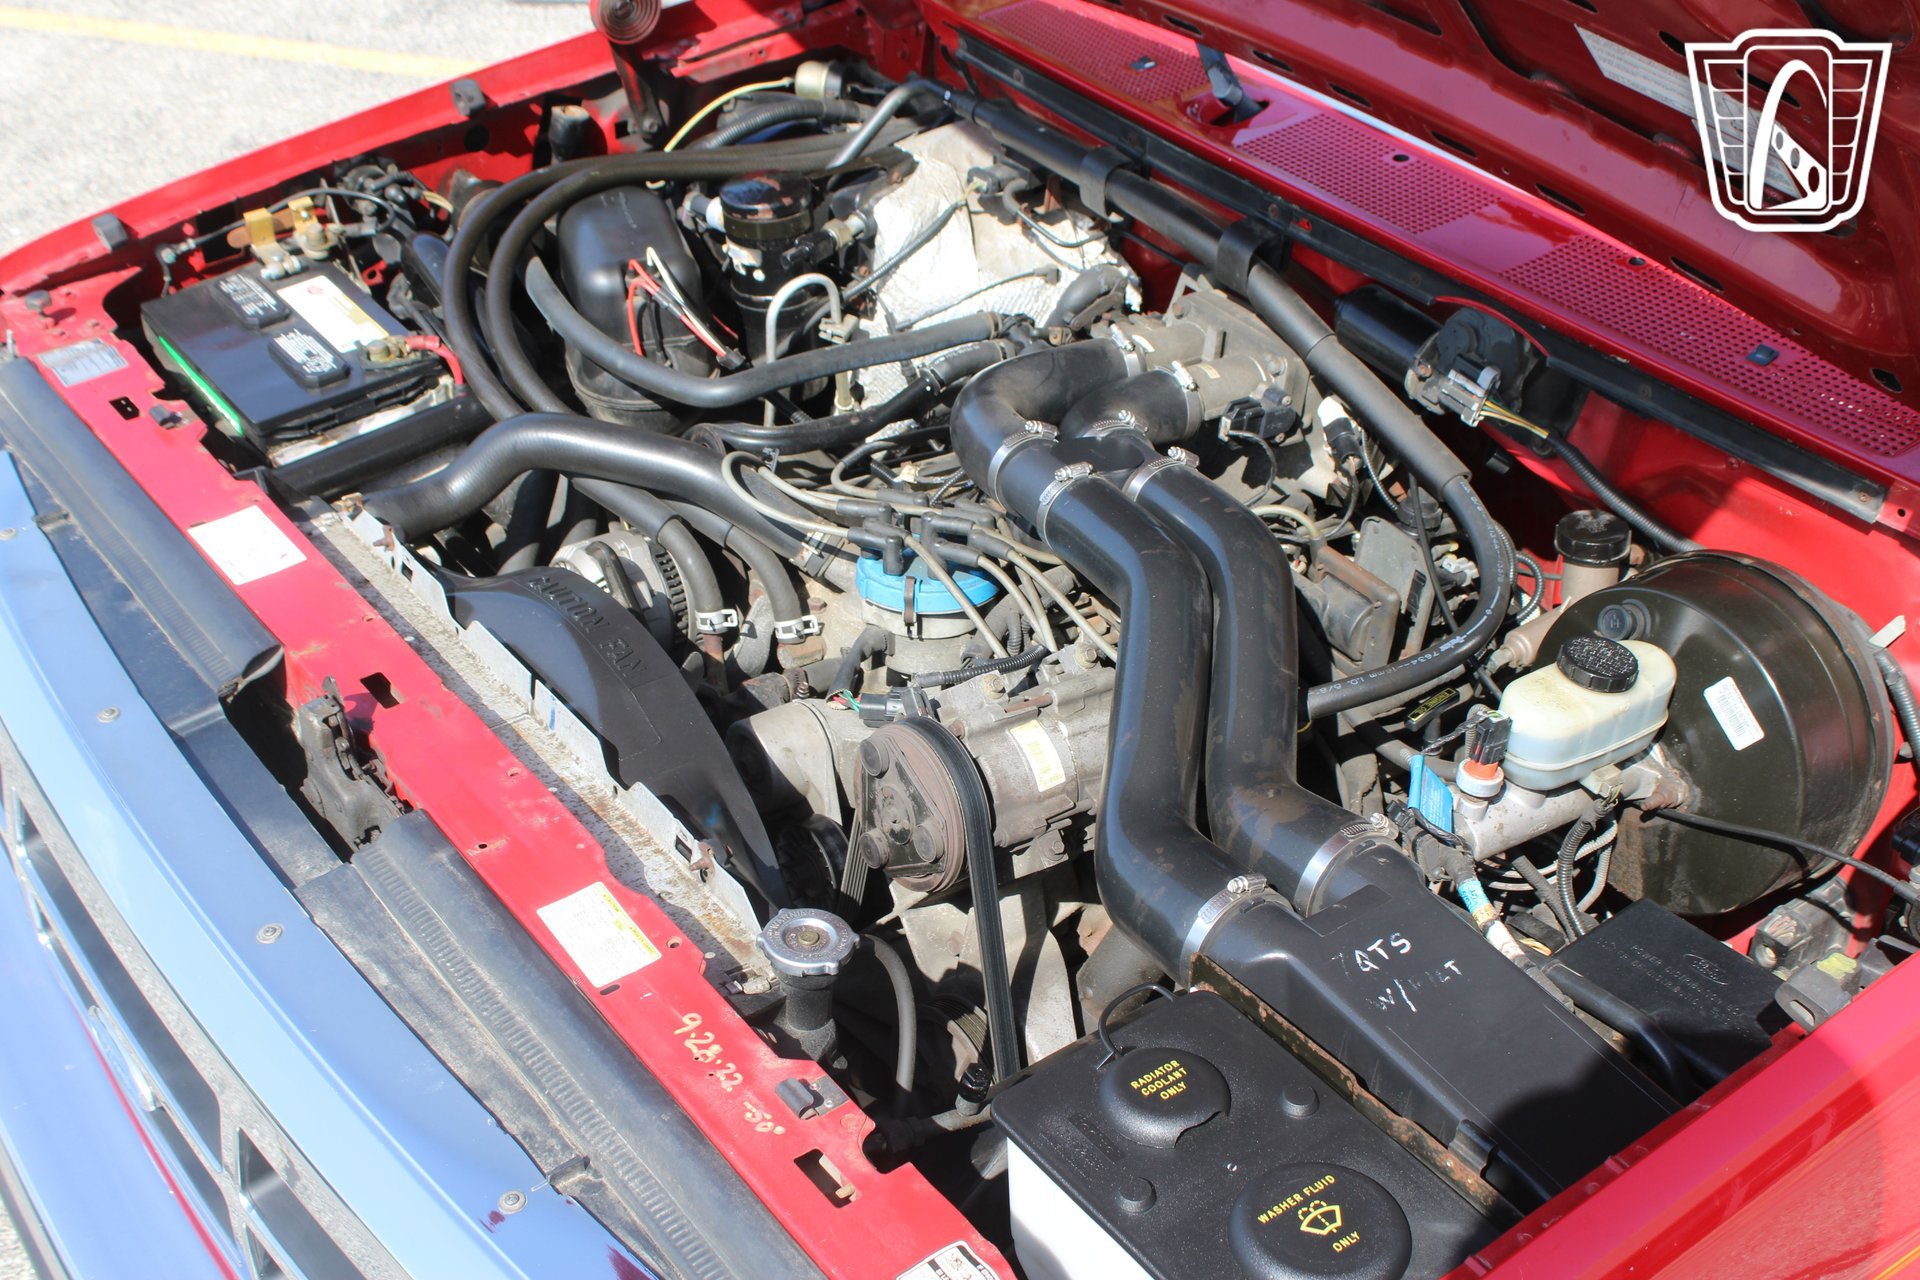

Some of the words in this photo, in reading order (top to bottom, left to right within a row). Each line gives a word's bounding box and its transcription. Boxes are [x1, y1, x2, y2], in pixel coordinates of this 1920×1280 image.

[1130, 1060, 1180, 1089] RADIATOR
[1141, 1067, 1188, 1096] COOLANT
[1159, 1081, 1187, 1100] ONLY
[1257, 1193, 1304, 1224] WASHER
[1302, 1174, 1337, 1197] FLUID
[1332, 1230, 1361, 1253] ONLY
